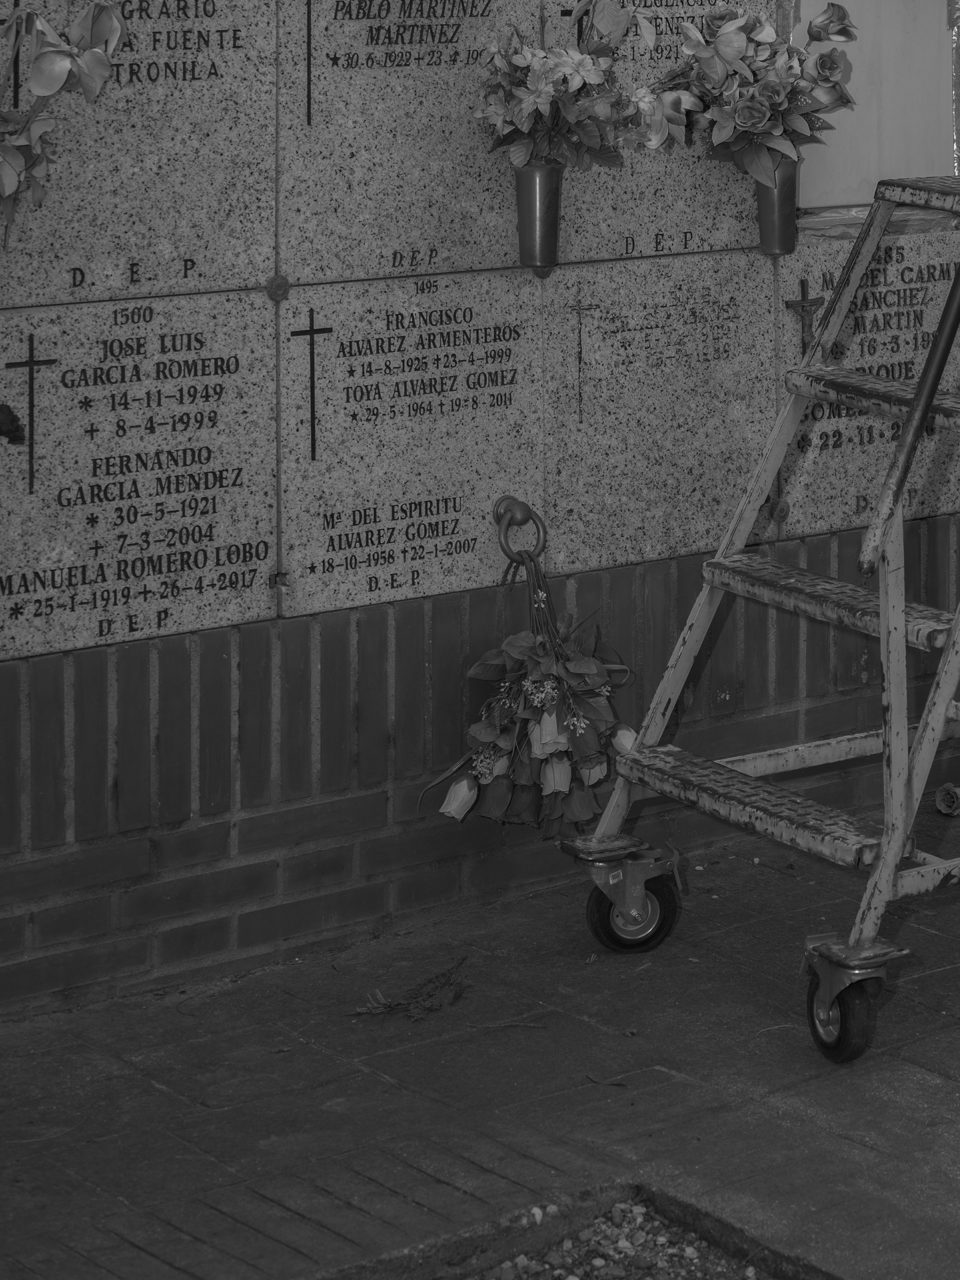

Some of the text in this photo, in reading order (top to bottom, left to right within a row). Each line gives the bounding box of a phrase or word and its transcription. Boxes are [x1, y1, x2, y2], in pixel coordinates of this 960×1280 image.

[333, 0, 391, 21] PABLO
[151, 29, 243, 52] FUENTE
[365, 23, 461, 46] MARTINEZ
[415, 280, 439, 295] 1495
[112, 306, 154, 326] 1500
[386, 307, 473, 331] FRANCISCO
[853, 309, 924, 335] MARTIN
[100, 332, 205, 363] JOSE LUIS
[336, 324, 521, 359] ALVAREZ ARMENTEROS
[61, 355, 240, 389] GARCIA ROMERO
[343, 369, 518, 404] TOYA ALVAREZ GOMEZ
[109, 383, 226, 411] 14-11-1949
[115, 411, 219, 438] 8-4-1999
[91, 446, 212, 478] FERNANDO
[57, 468, 244, 508] GARCIA MENDEZ
[113, 496, 218, 527] 30-5-1921
[352, 496, 464, 526] DEL ESPIRITU
[117, 523, 214, 554] 7-3-2004
[326, 527, 397, 553] ALVAREZ
[0, 540, 270, 596] MANUELA ROMERO LOBO
